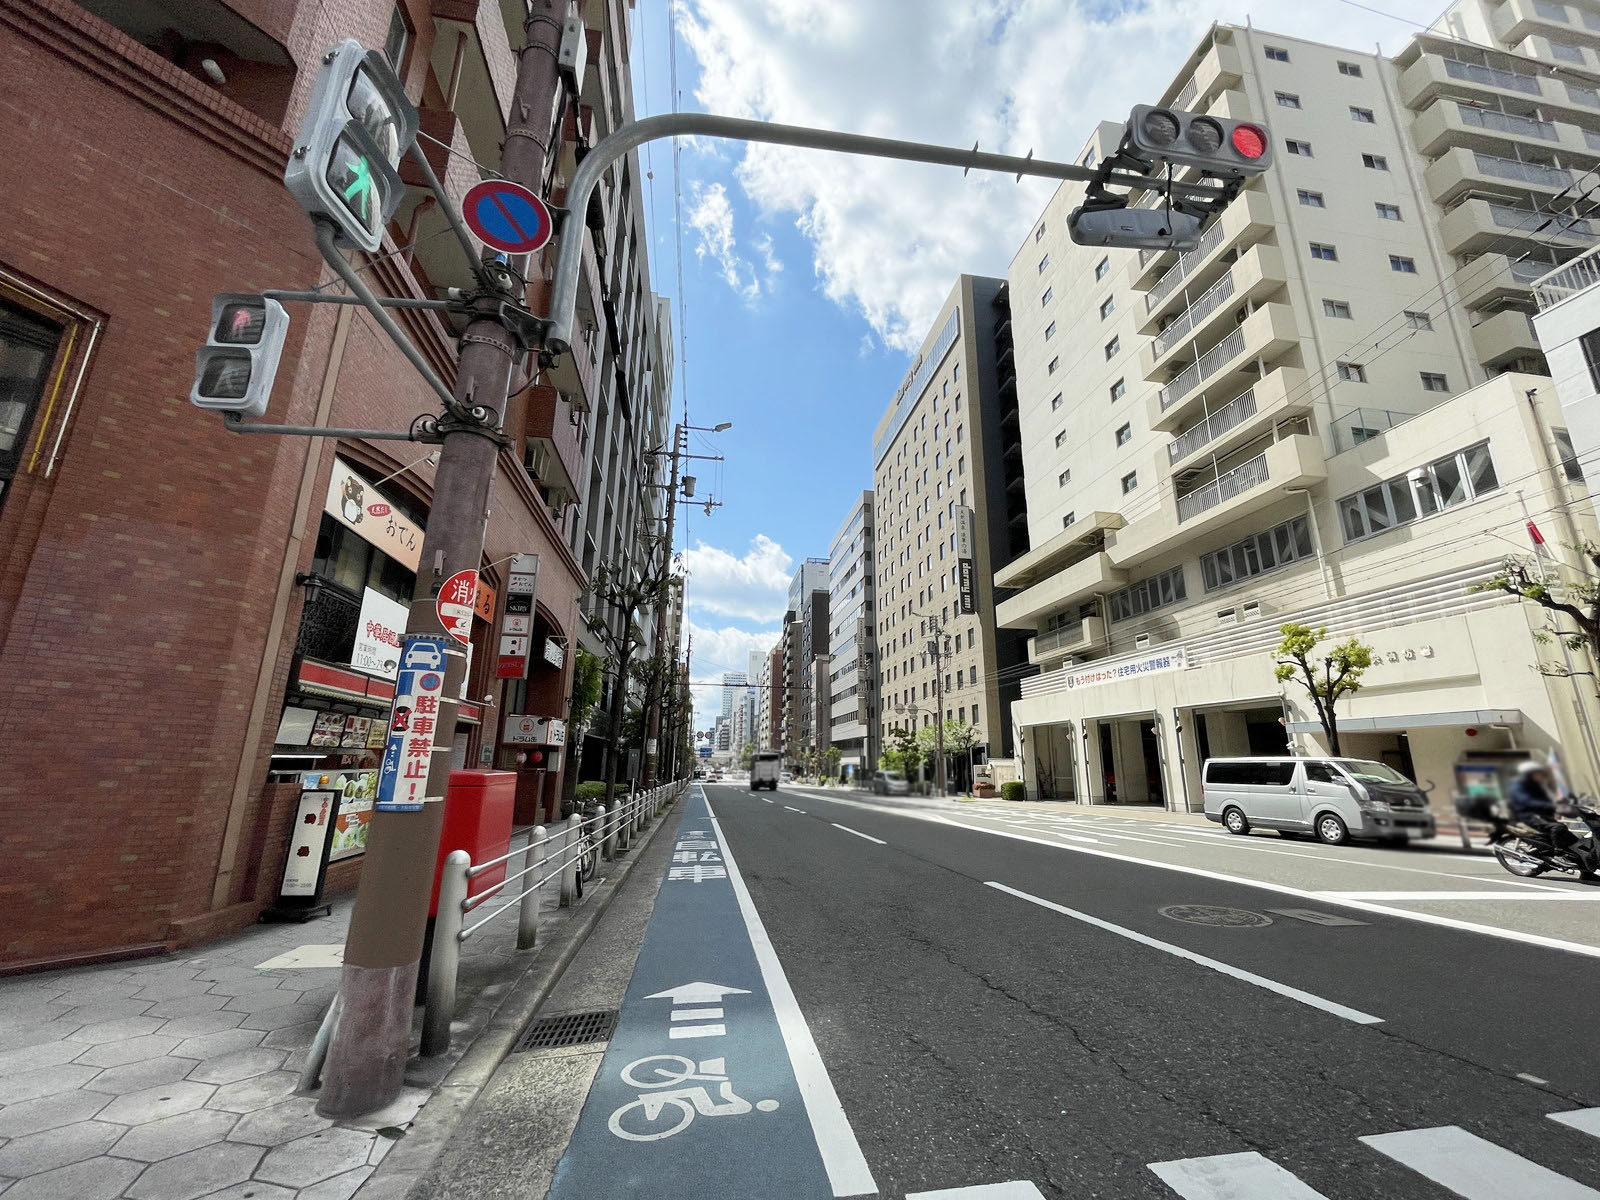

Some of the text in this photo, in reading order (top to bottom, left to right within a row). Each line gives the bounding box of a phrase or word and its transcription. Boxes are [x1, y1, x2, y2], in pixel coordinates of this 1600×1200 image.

[385, 514, 418, 552] おでん
[961, 562, 972, 593] dormy
[667, 840, 727, 883] 自転車
